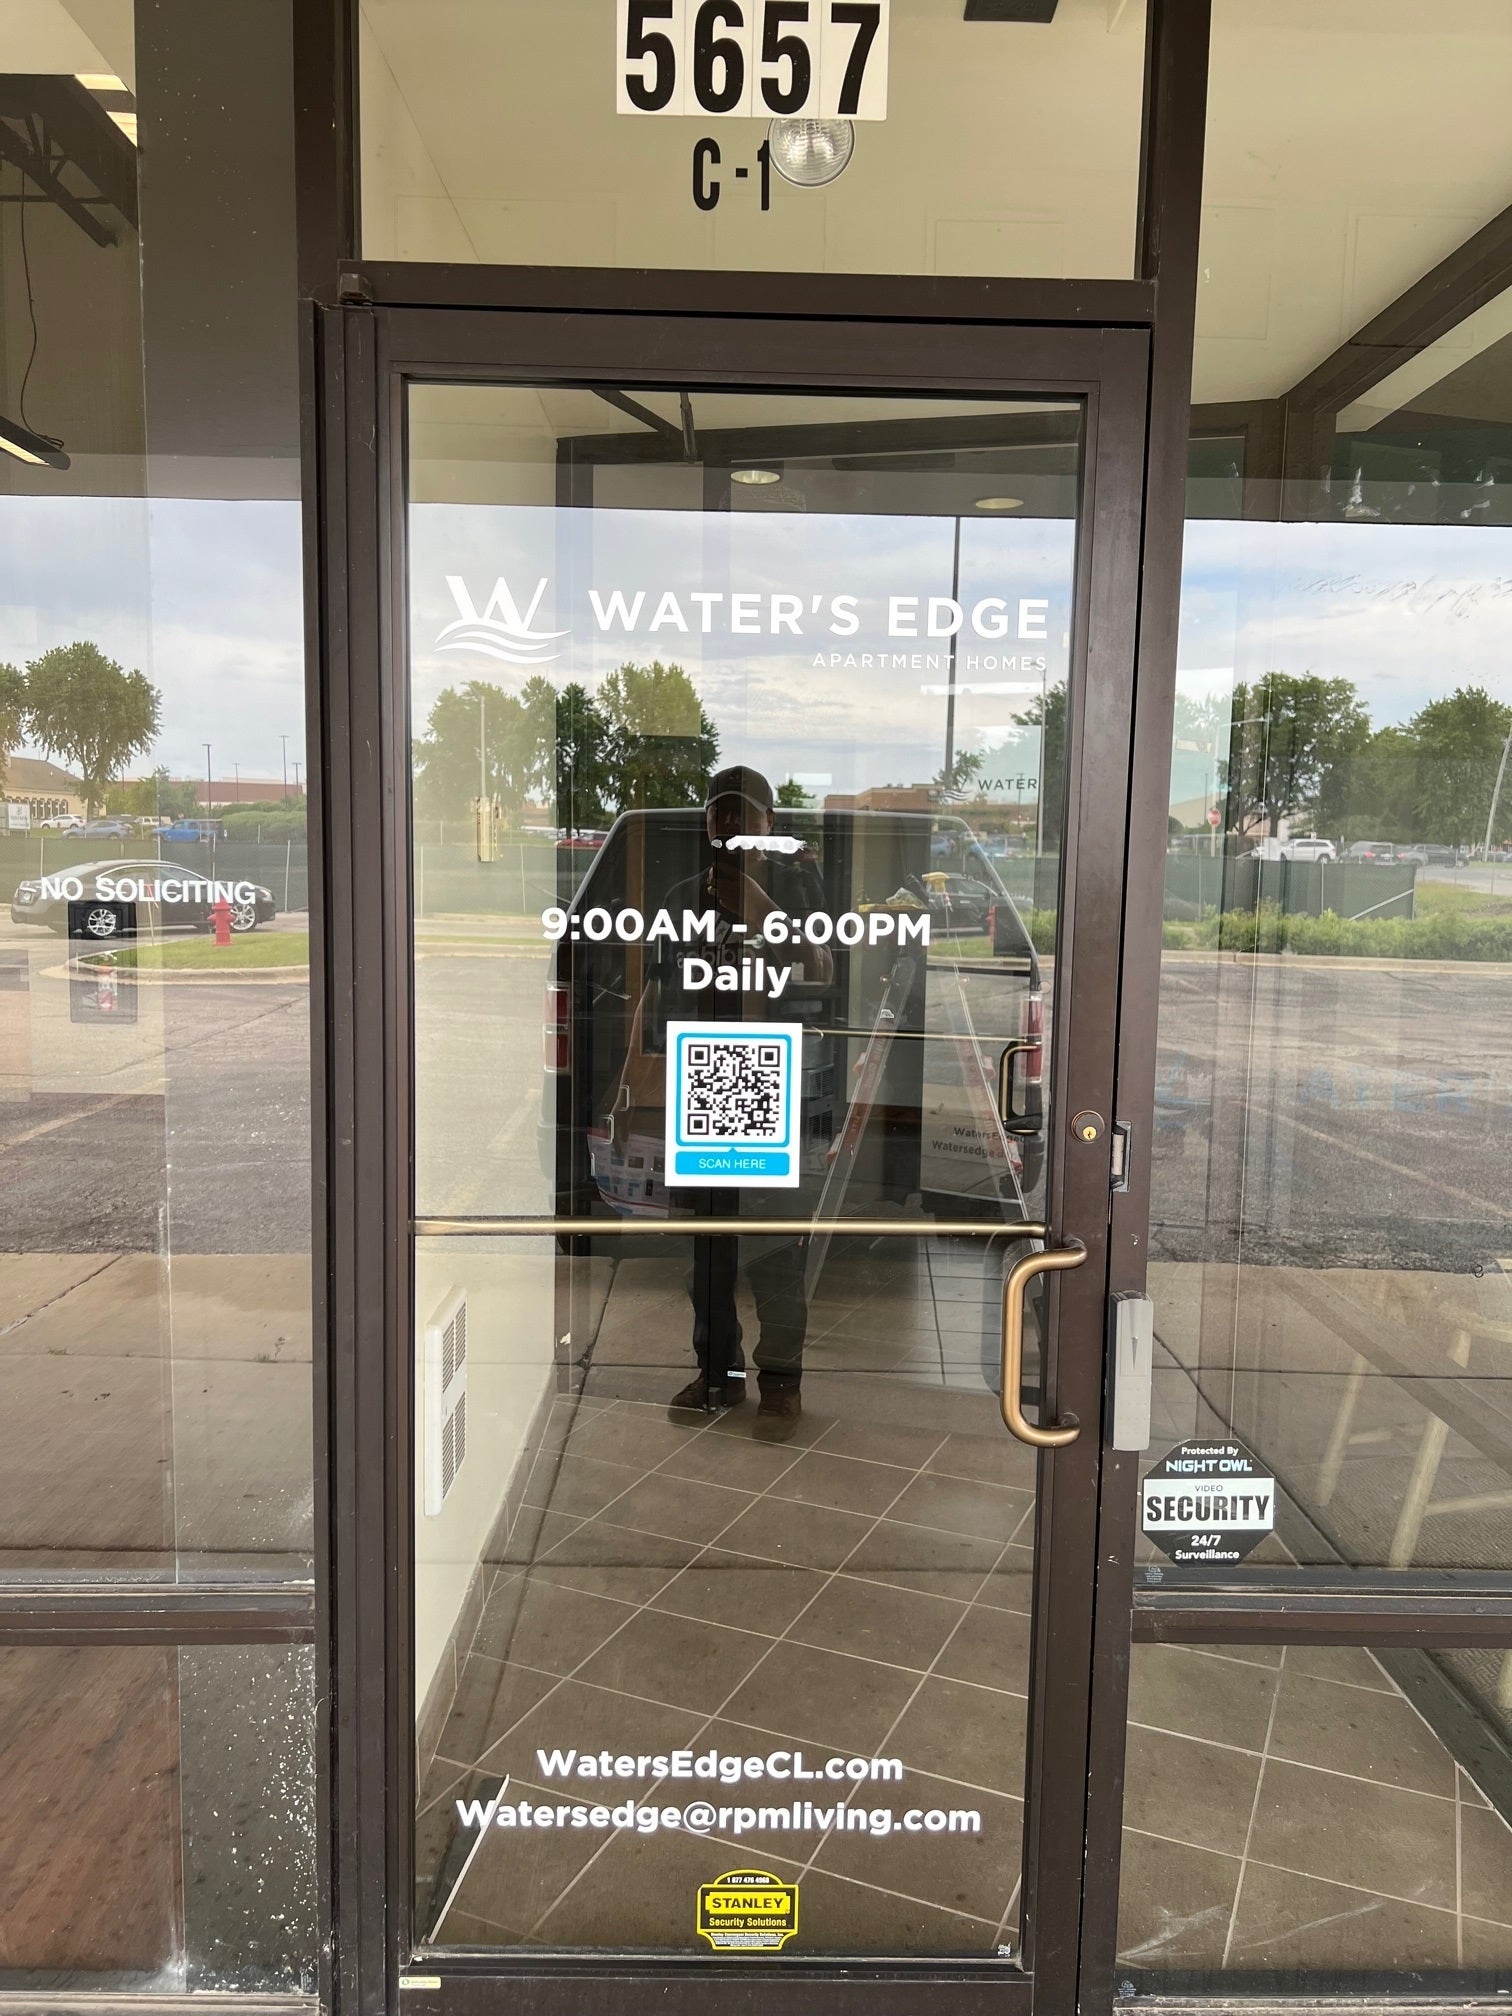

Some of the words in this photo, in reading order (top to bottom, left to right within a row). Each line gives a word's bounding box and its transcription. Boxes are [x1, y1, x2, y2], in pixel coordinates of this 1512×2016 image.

[625, 0, 881, 115] 5657
[587, 589, 861, 637] WATER'S
[887, 596, 1050, 640] EDGE
[811, 651, 957, 670] APARTMENT
[965, 655, 1048, 673] HOMES
[40, 876, 84, 901] NO
[95, 880, 256, 905] SOLICITING
[541, 907, 718, 943] 9:00AM
[732, 923, 748, 933] -
[762, 911, 932, 948] 6:00PM
[682, 957, 792, 999] Daily
[698, 1158, 731, 1169] SCAN
[734, 1158, 767, 1169] HERE
[1181, 1447, 1225, 1455] Protected
[1227, 1447, 1239, 1456] By
[1194, 1484, 1223, 1492] VIDEO
[1146, 1495, 1270, 1522] SECURITY
[1190, 1534, 1221, 1547] 24/7
[1175, 1549, 1240, 1560] Surveillance
[536, 1748, 904, 1783] WatersEdgeCL.com
[455, 1799, 982, 1836] Watersedge@rpmliving.com
[712, 1897, 784, 1909] STANLEY
[709, 1917, 744, 1928] Security
[746, 1917, 787, 1927] Solutions
